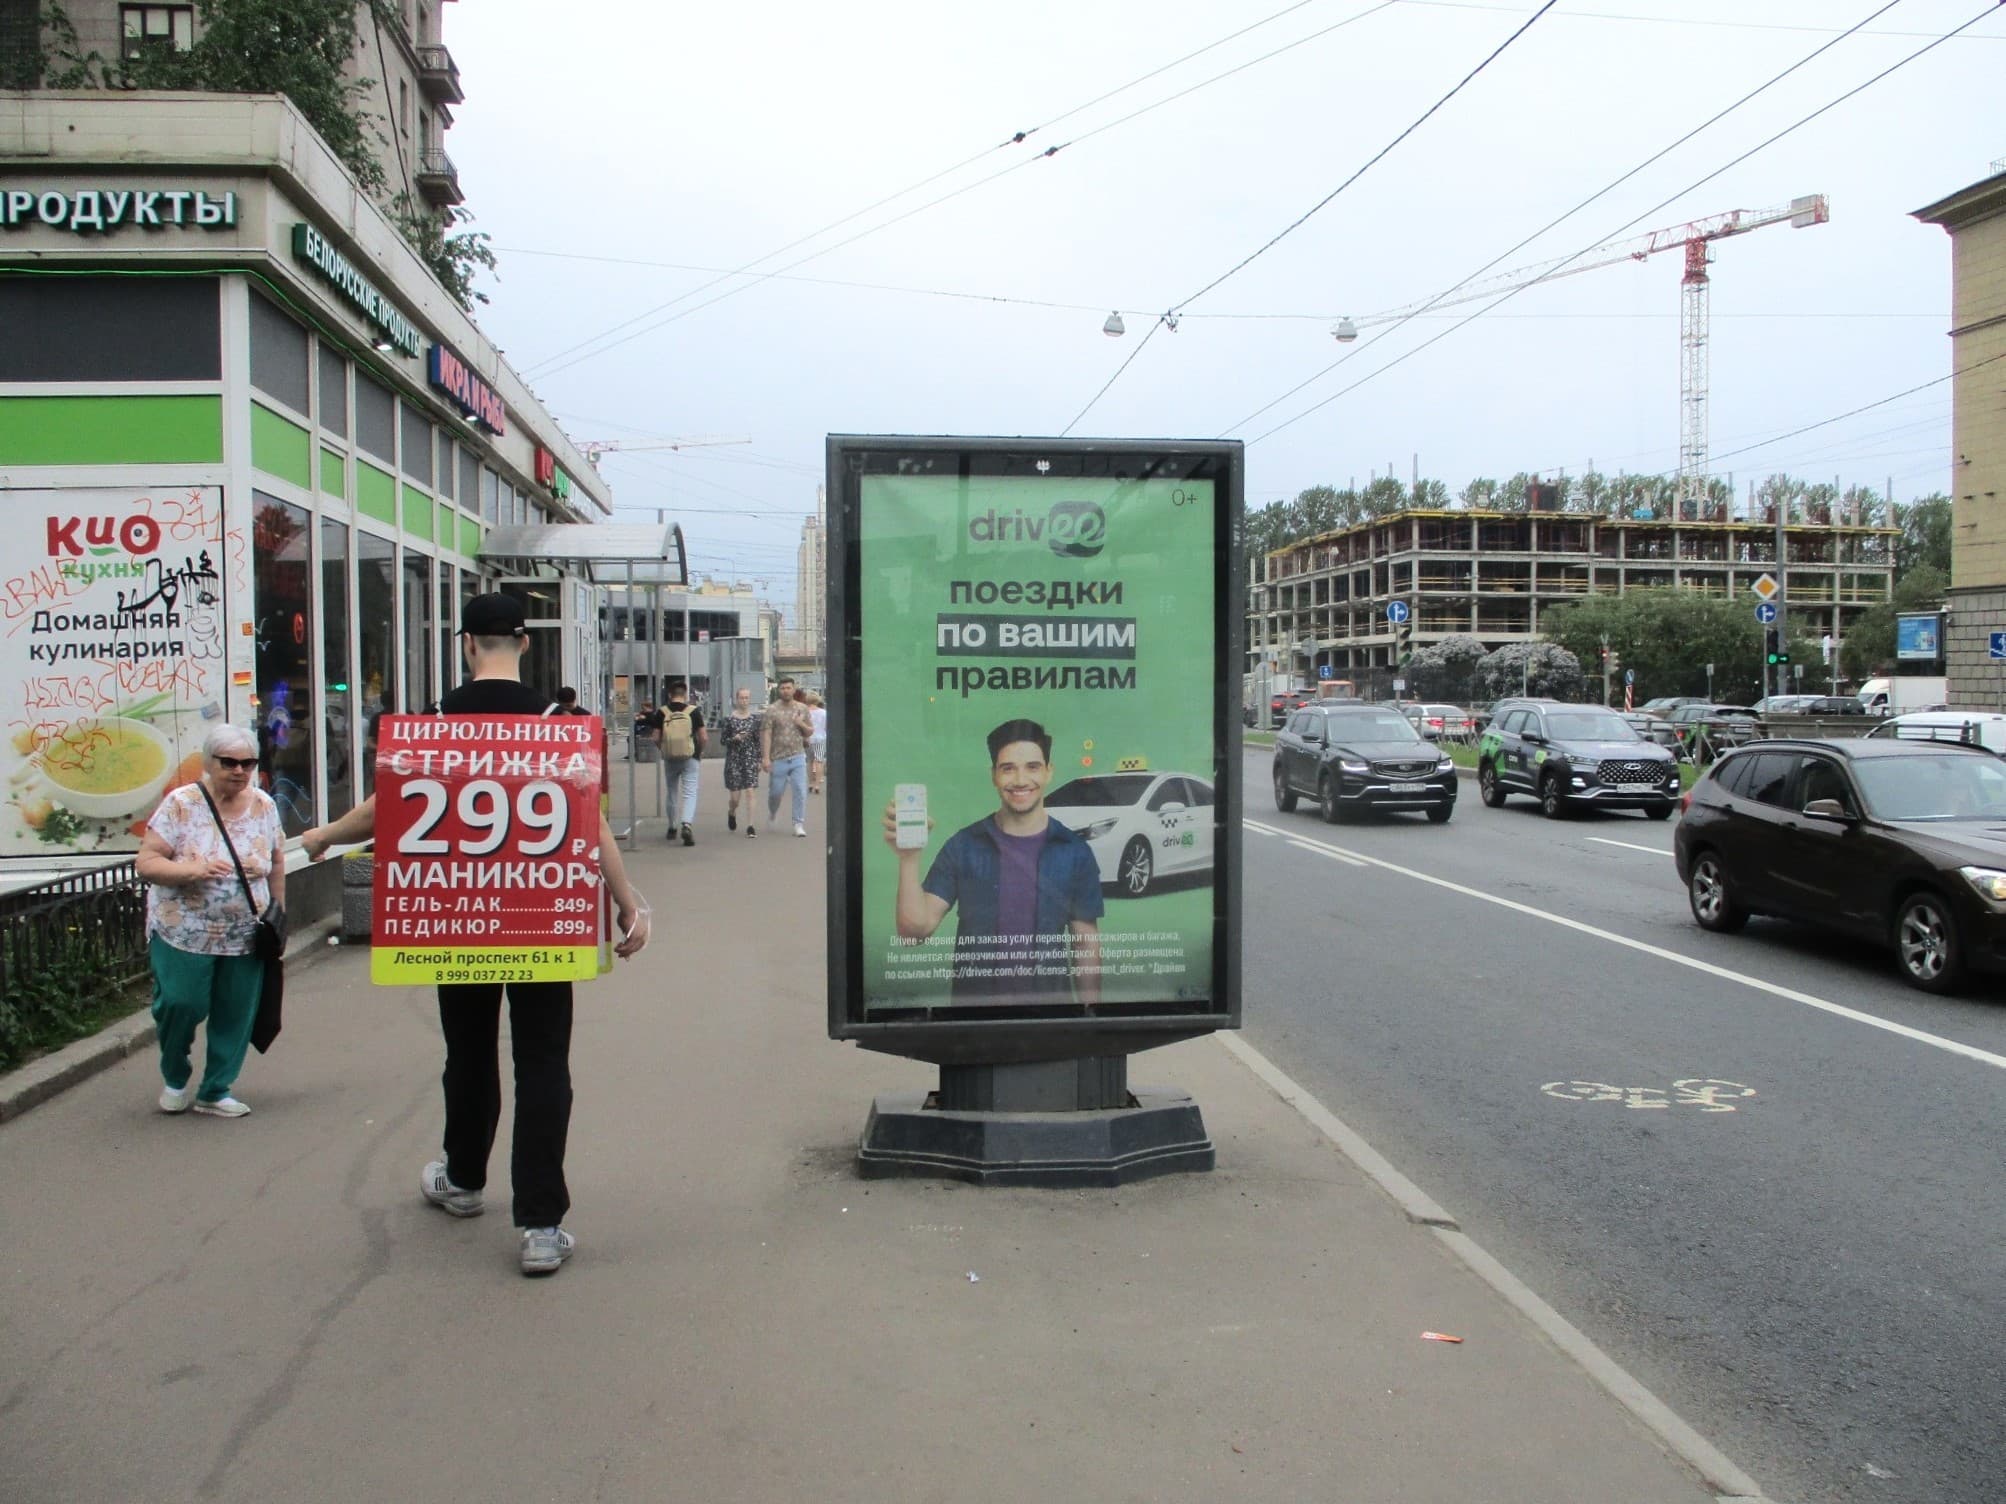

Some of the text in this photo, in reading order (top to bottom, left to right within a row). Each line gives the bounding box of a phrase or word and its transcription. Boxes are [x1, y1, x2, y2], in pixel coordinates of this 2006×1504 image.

[0, 190, 235, 230] РОДУКТЫ
[306, 224, 420, 358] БЕЛОРУССКИЕ ПРОДУКТЫ
[440, 344, 471, 407] ИКРА
[480, 383, 505, 434] РЫБА
[1171, 488, 1198, 507] 0+
[968, 503, 1105, 553] drivee
[63, 562, 146, 585] кухня
[950, 580, 1123, 610] поездки
[32, 610, 181, 634] Домашняя
[937, 622, 1136, 648] по вашим
[30, 640, 184, 666] кулинария
[936, 665, 1136, 699] правилам
[392, 721, 592, 744] ЦИРЮЛЬНИКЪ
[391, 749, 588, 777] СТРИЖКА
[387, 861, 588, 890] МАНИКЮР
[924, 935, 956, 946] сервис
[958, 935, 976, 946] для
[977, 935, 1007, 945] заказа
[1009, 934, 1033, 946] услуг
[394, 951, 576, 967] Лесной проспект 61 к 1
[944, 951, 1008, 962] перевозчиком
[1010, 951, 1027, 961] или
[1028, 949, 1068, 962] службой
[435, 969, 534, 981] 8 999 037 22 23
[885, 970, 896, 980] по
